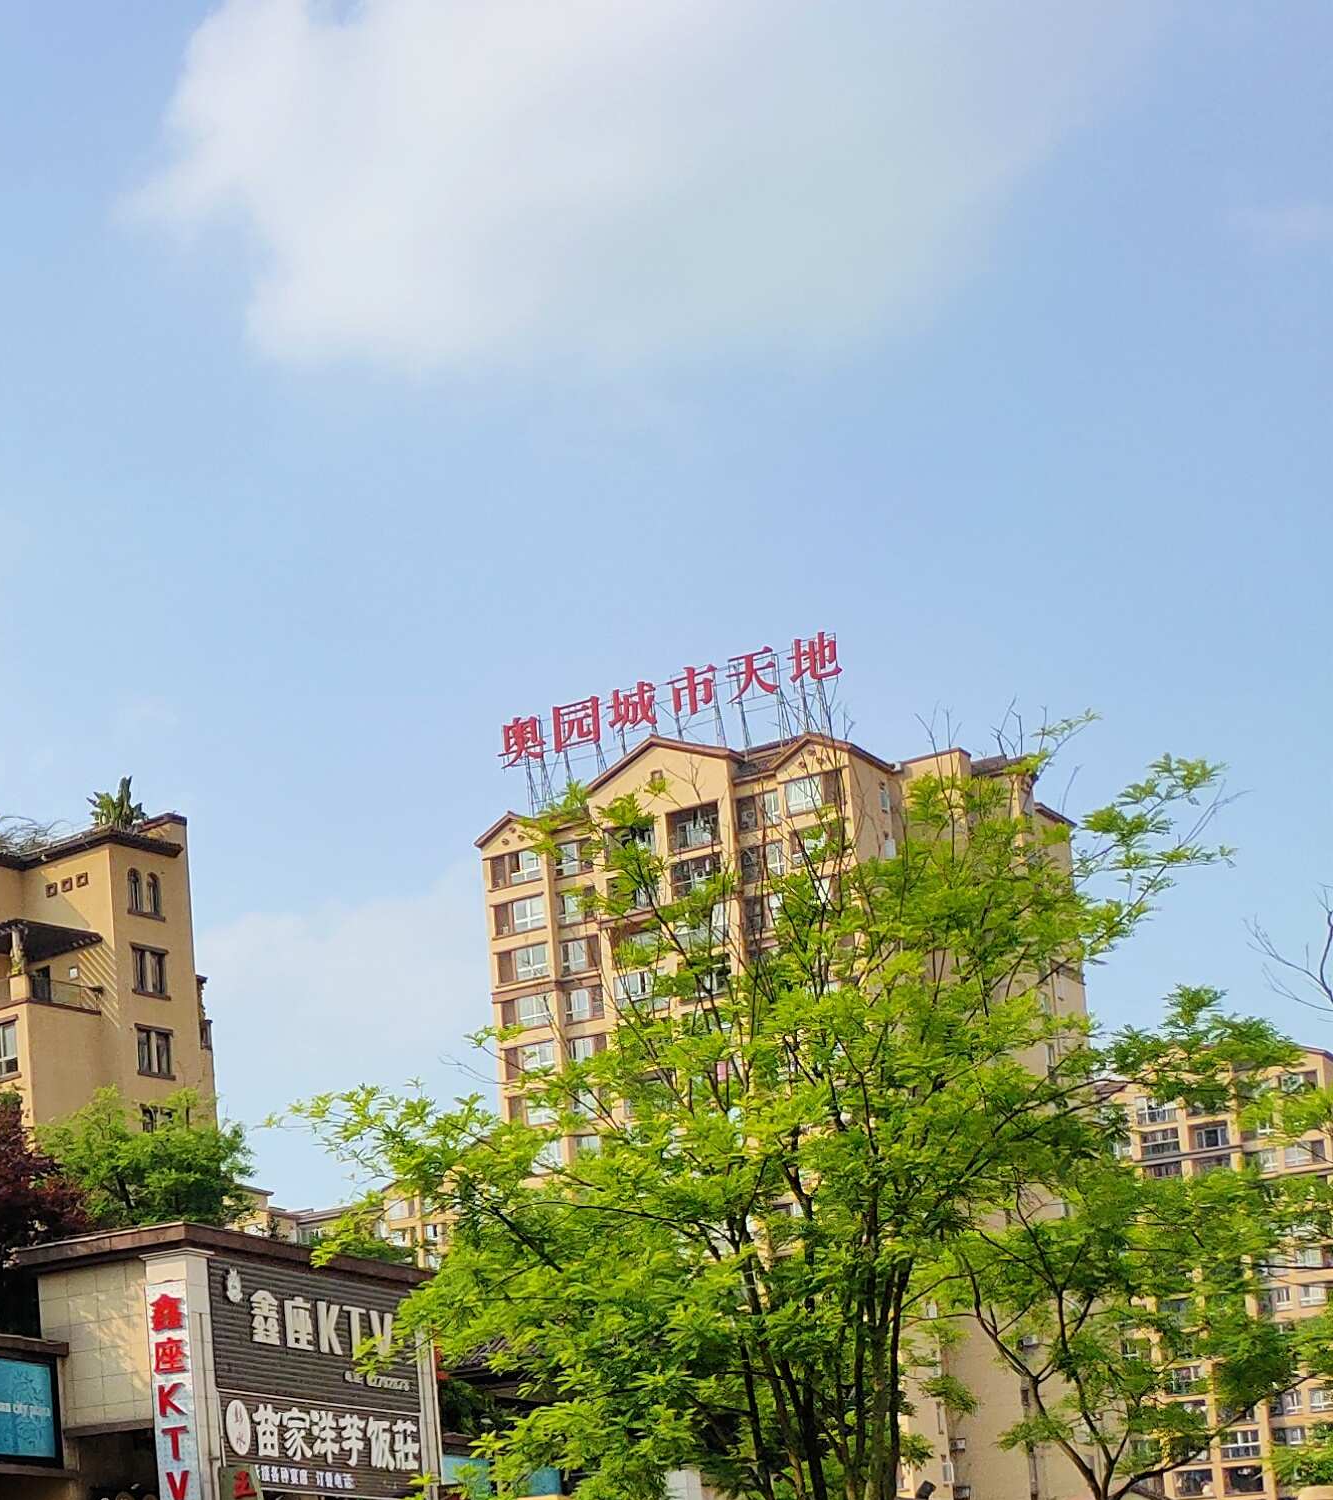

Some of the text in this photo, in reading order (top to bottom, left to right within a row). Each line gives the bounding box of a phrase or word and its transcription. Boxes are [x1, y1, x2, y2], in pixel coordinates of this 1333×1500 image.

[498, 632, 842, 769] 奥园城市天地
[250, 1289, 393, 1361] 鑫座KTV
[13, 1402, 29, 1418] city
